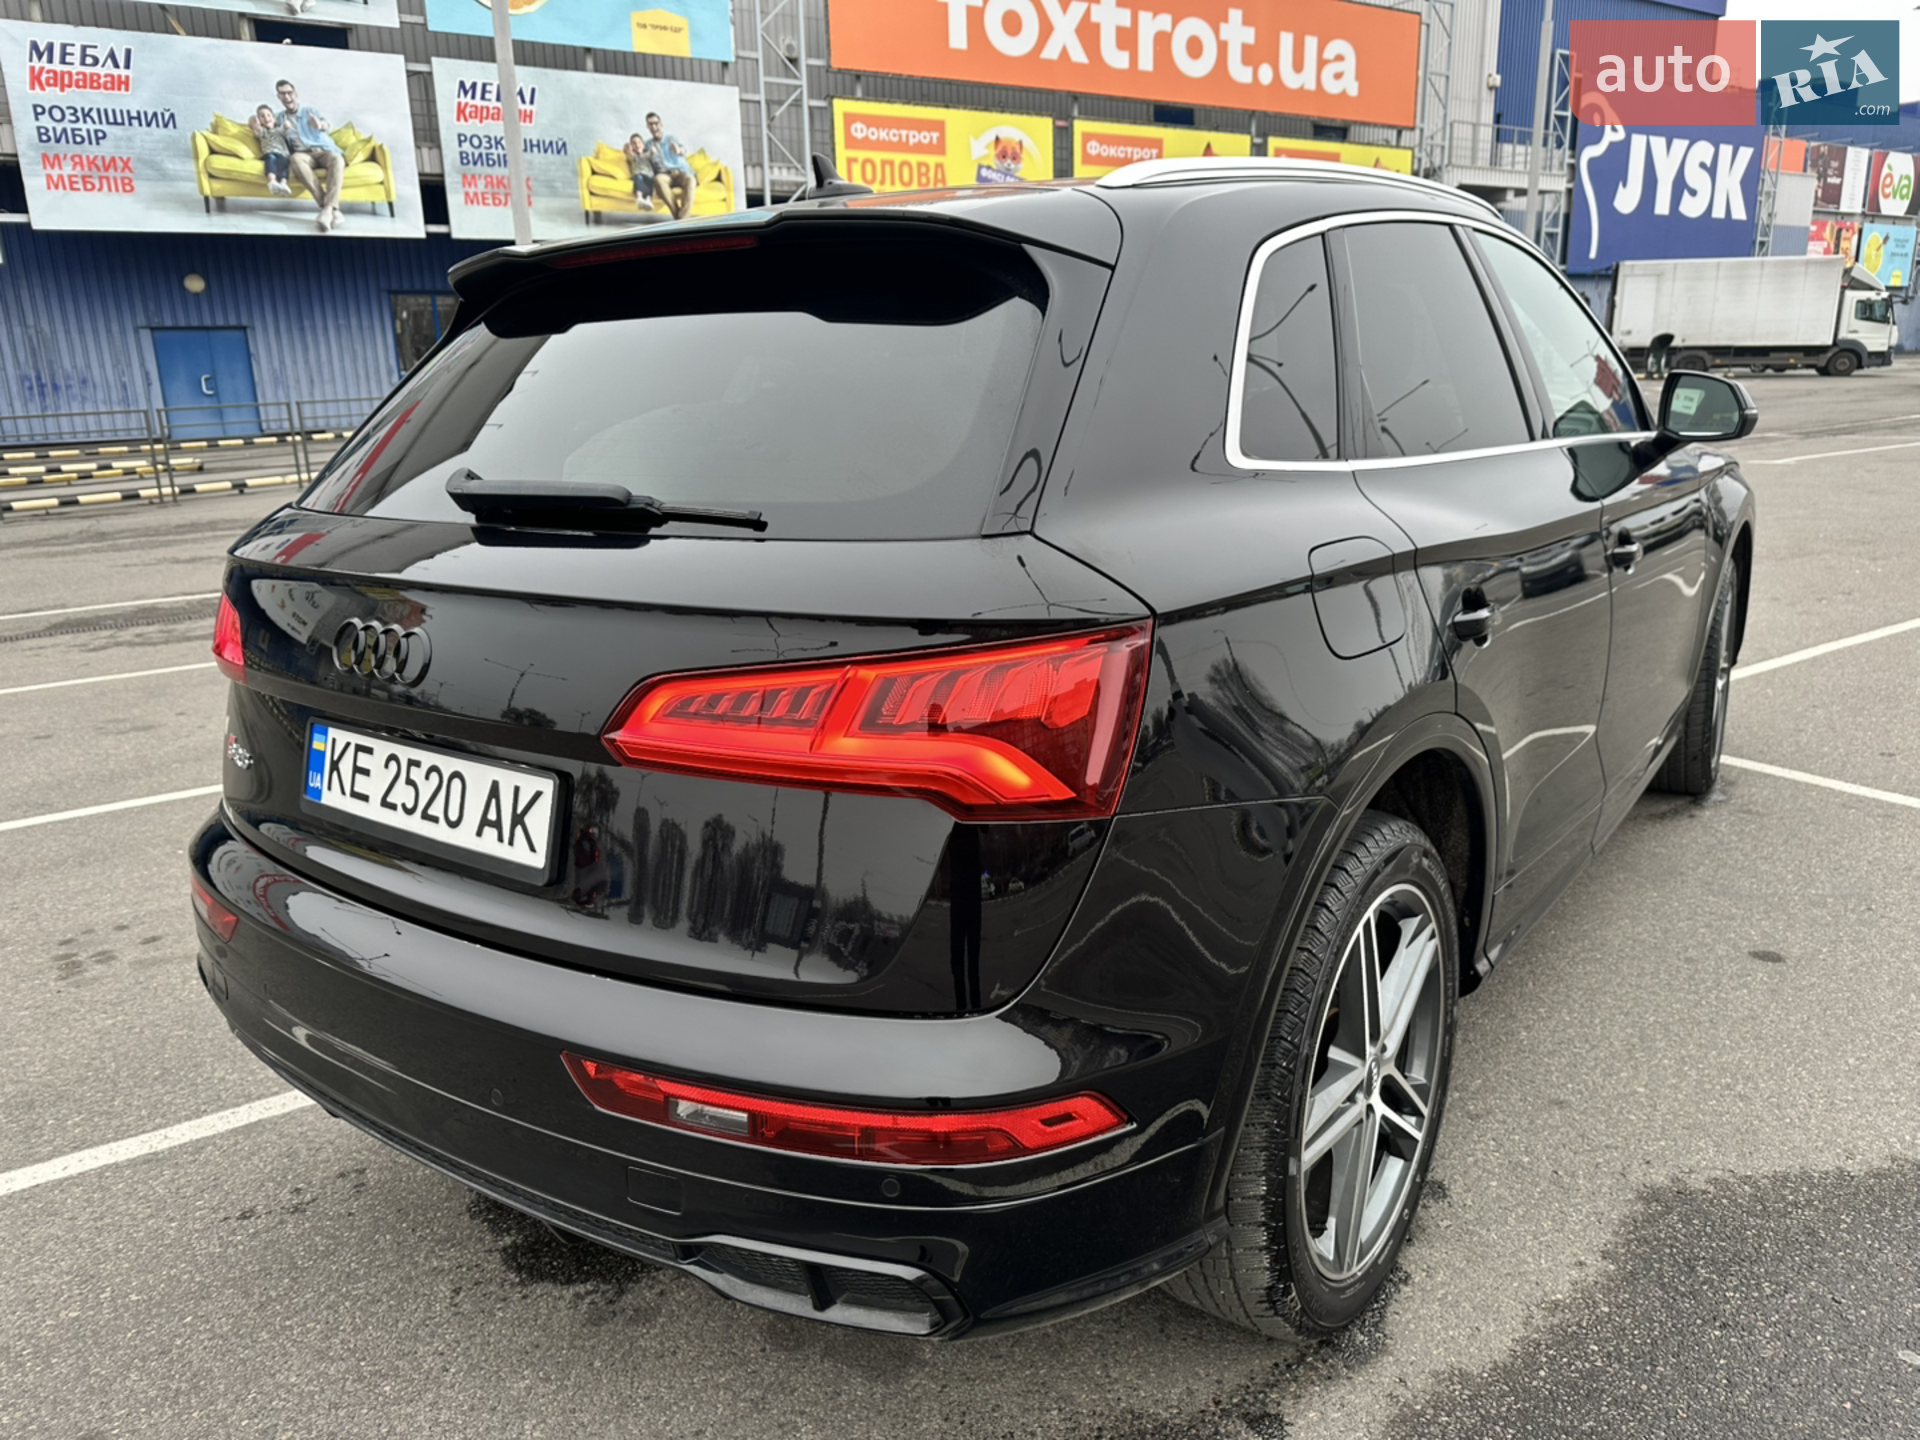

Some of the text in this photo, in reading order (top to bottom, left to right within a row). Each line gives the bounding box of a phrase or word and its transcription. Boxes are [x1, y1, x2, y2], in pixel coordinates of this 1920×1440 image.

[28, 39, 133, 70] МЕБЛІ
[28, 65, 131, 93] Караван
[32, 103, 177, 129] РОЗКІШНИЙ
[36, 125, 107, 146] ВИБІР
[457, 132, 568, 156] РОЗКНИЙ
[850, 121, 940, 146] Фокстрот
[40, 152, 135, 174] М'ЯКИХ
[1086, 139, 1159, 162] Фокстрот
[45, 173, 136, 194] МЕБЛІВ
[846, 156, 947, 188] ГОЛОВА
[1613, 133, 1754, 221] JYSK
[308, 770, 321, 791] UA
[326, 737, 544, 854] KE 2520 AK
